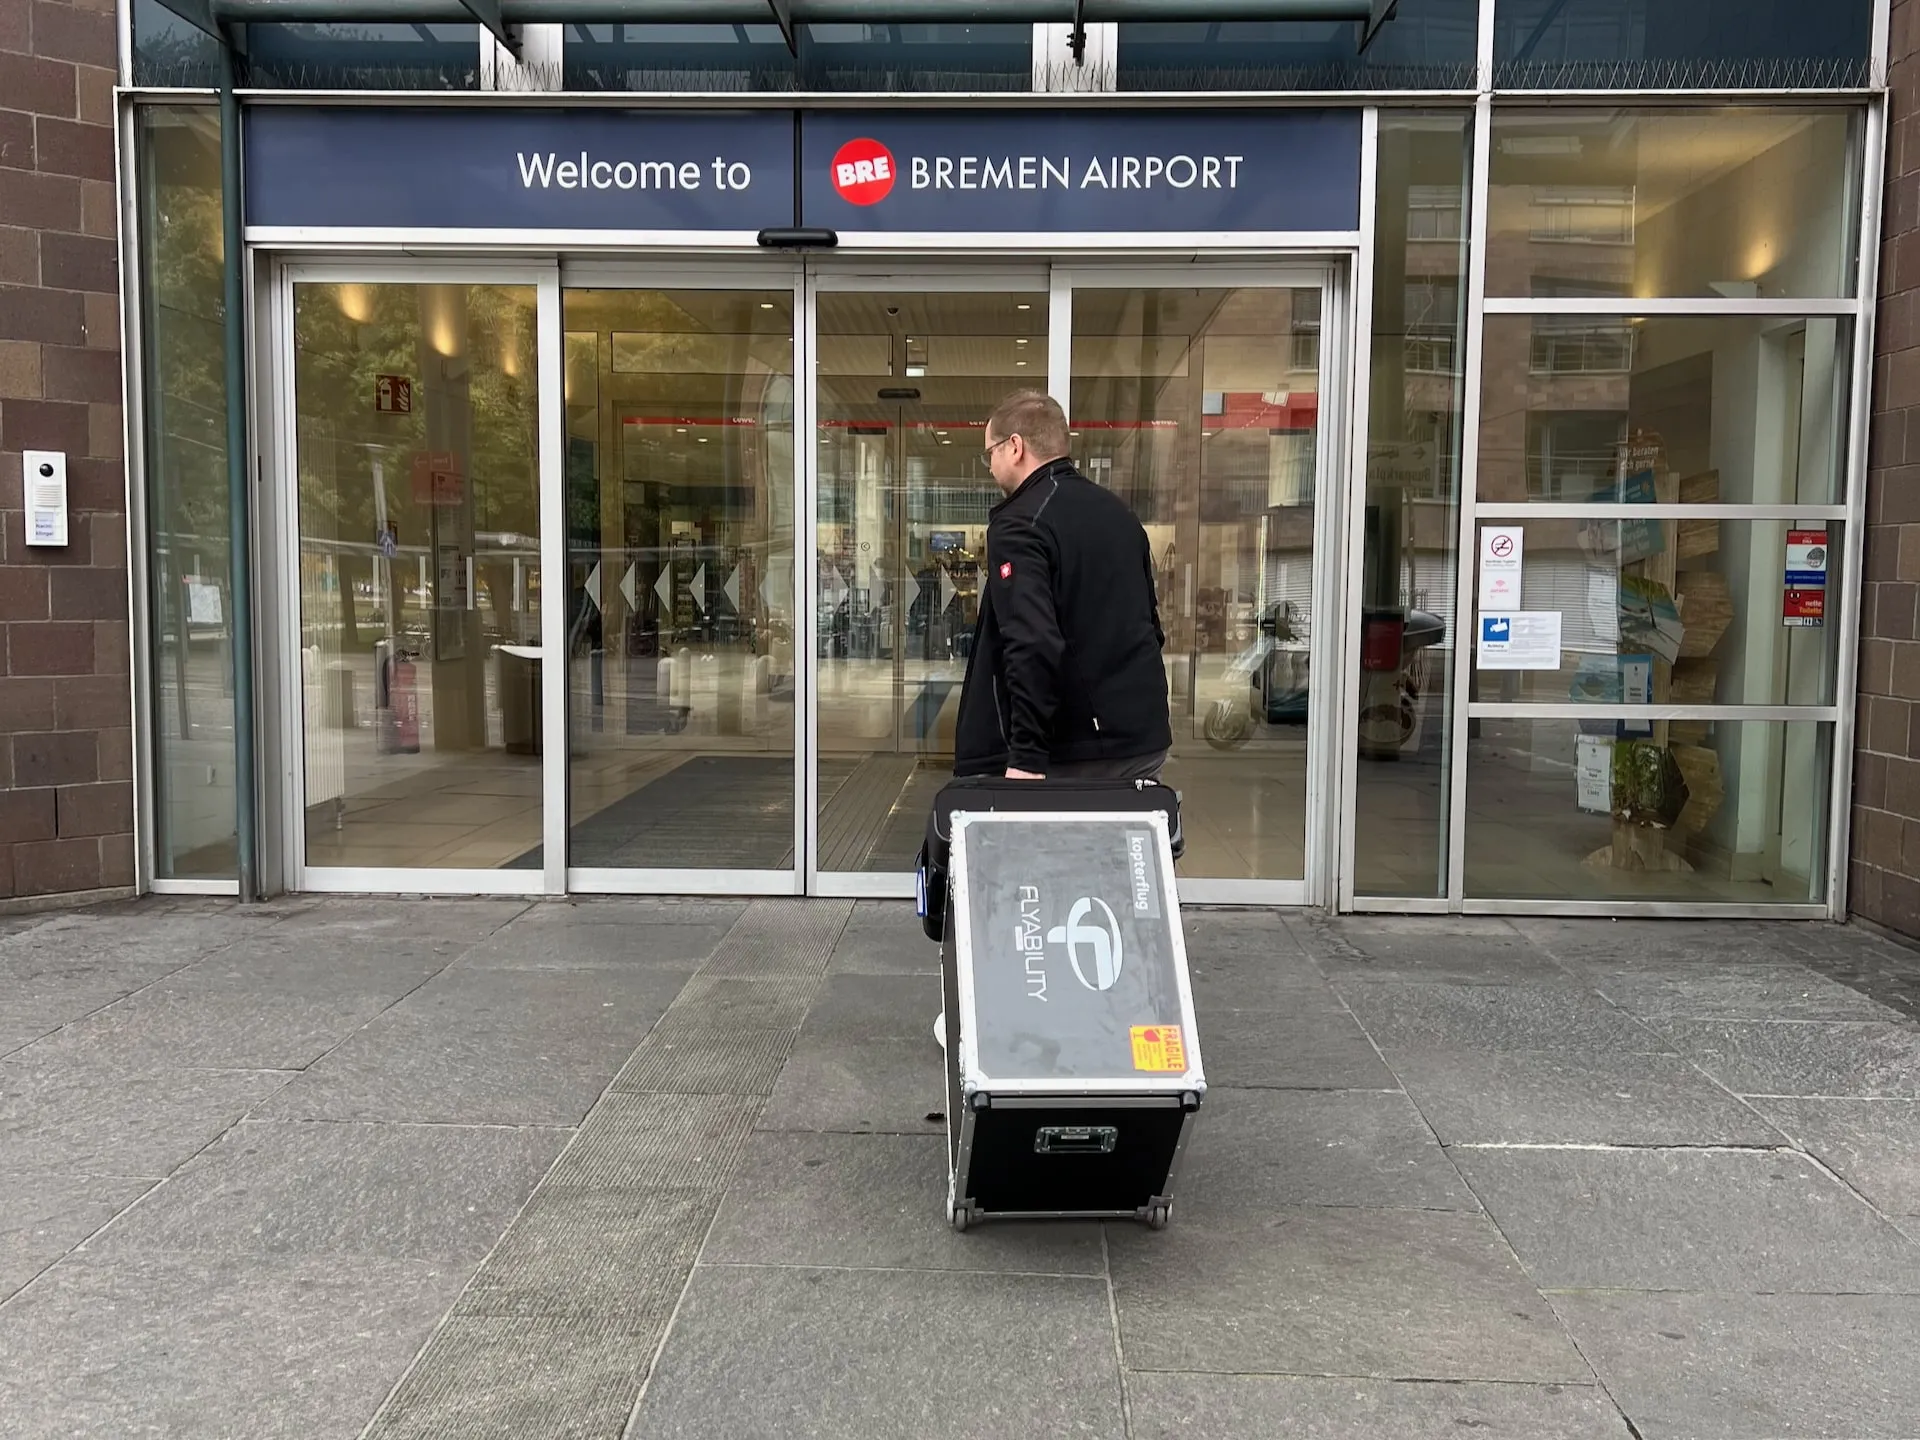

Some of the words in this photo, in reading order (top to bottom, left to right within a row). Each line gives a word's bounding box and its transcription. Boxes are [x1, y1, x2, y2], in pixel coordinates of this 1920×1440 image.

[516, 151, 701, 190] Welcome
[711, 156, 751, 190] to
[836, 155, 891, 188] BRE
[911, 155, 1070, 190] BREMEN
[1080, 155, 1244, 190] AIRPORT
[1130, 836, 1150, 911] kopterflug
[1019, 885, 1048, 1002] FLYABILITY
[1162, 1028, 1183, 1069] FRAGILE
